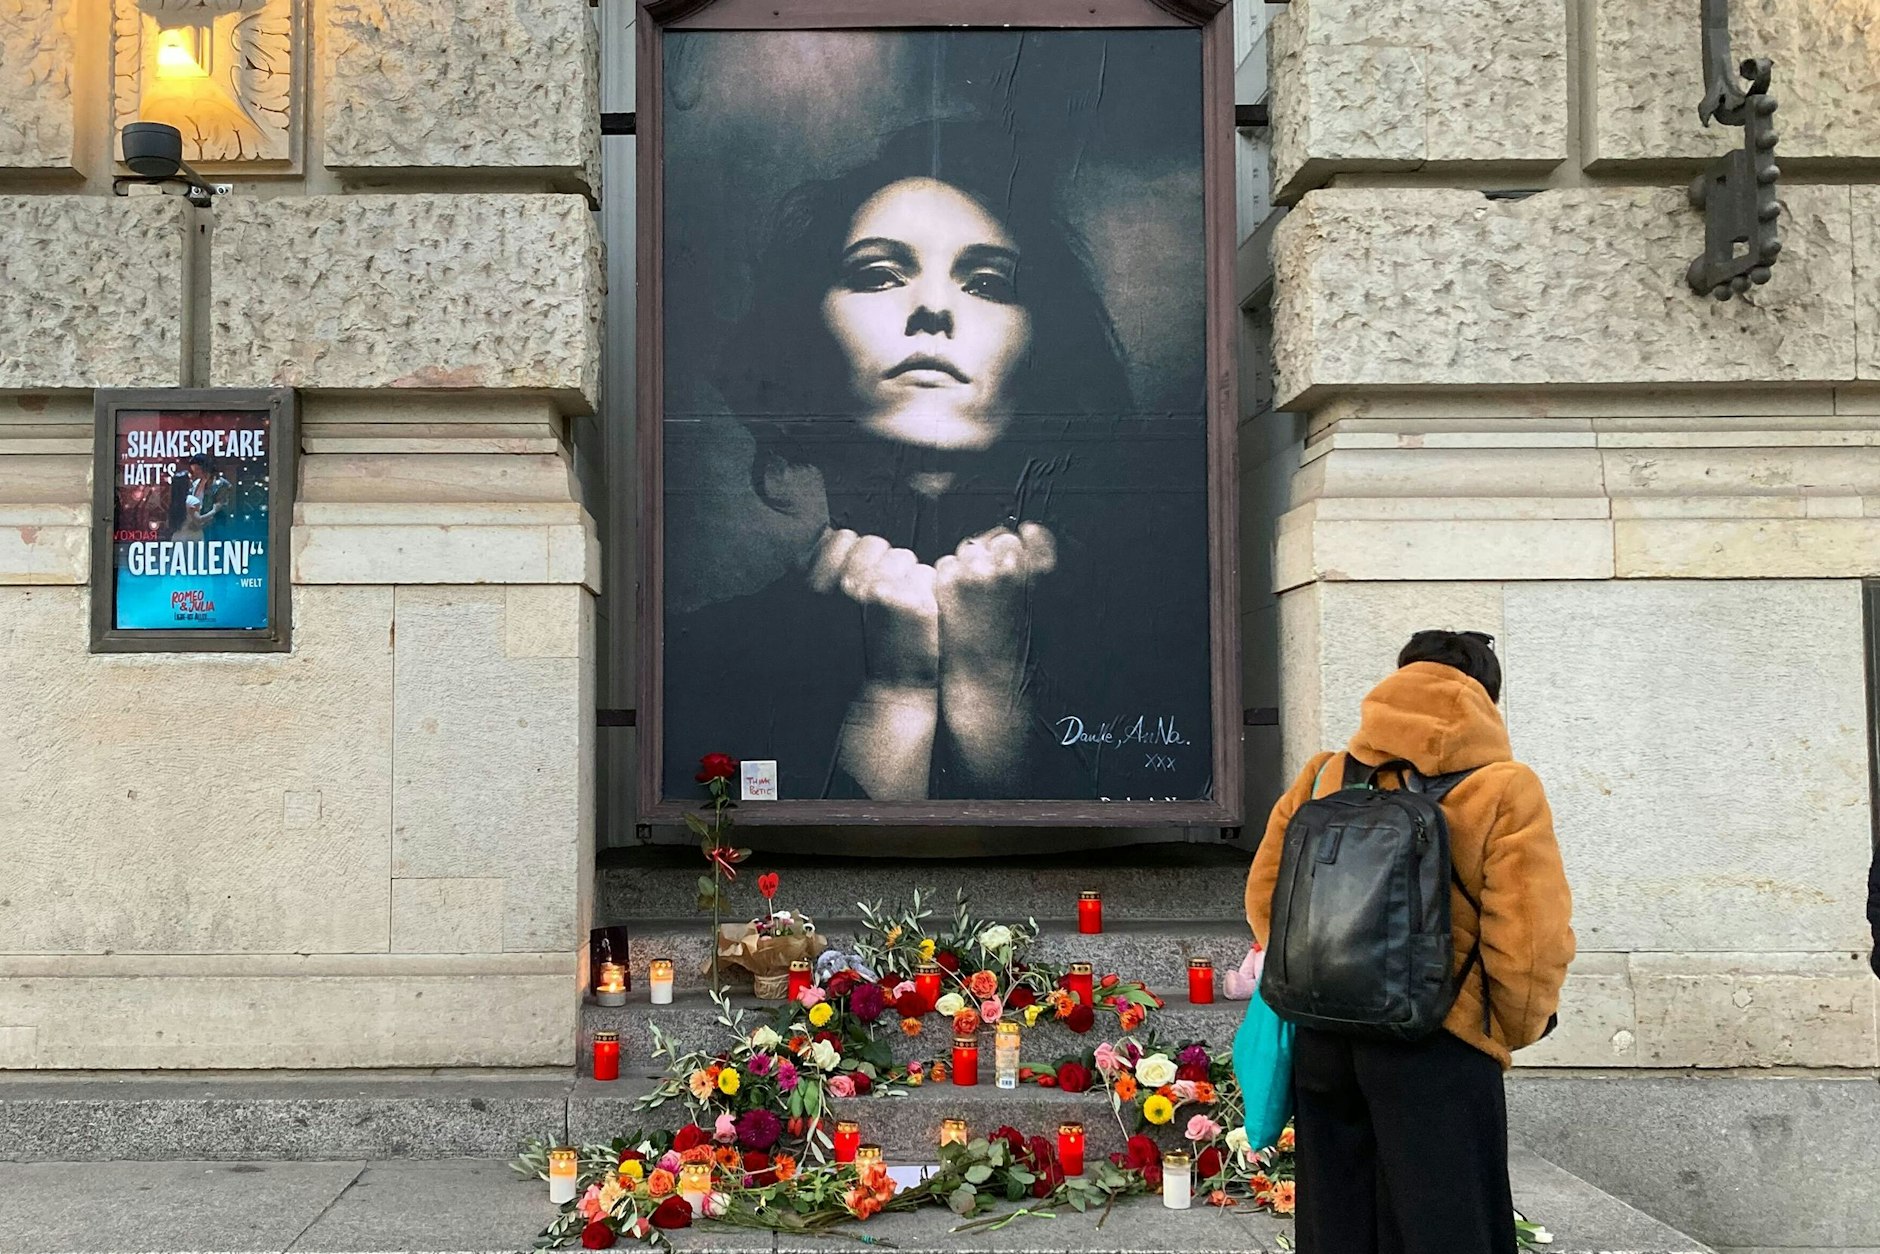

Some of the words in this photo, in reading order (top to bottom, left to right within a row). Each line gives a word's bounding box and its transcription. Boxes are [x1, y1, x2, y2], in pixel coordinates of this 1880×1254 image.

[240, 578, 263, 588] WELT
[172, 590, 204, 609] ROMEO
[180, 602, 188, 612] &
[189, 601, 216, 613] JULIA
